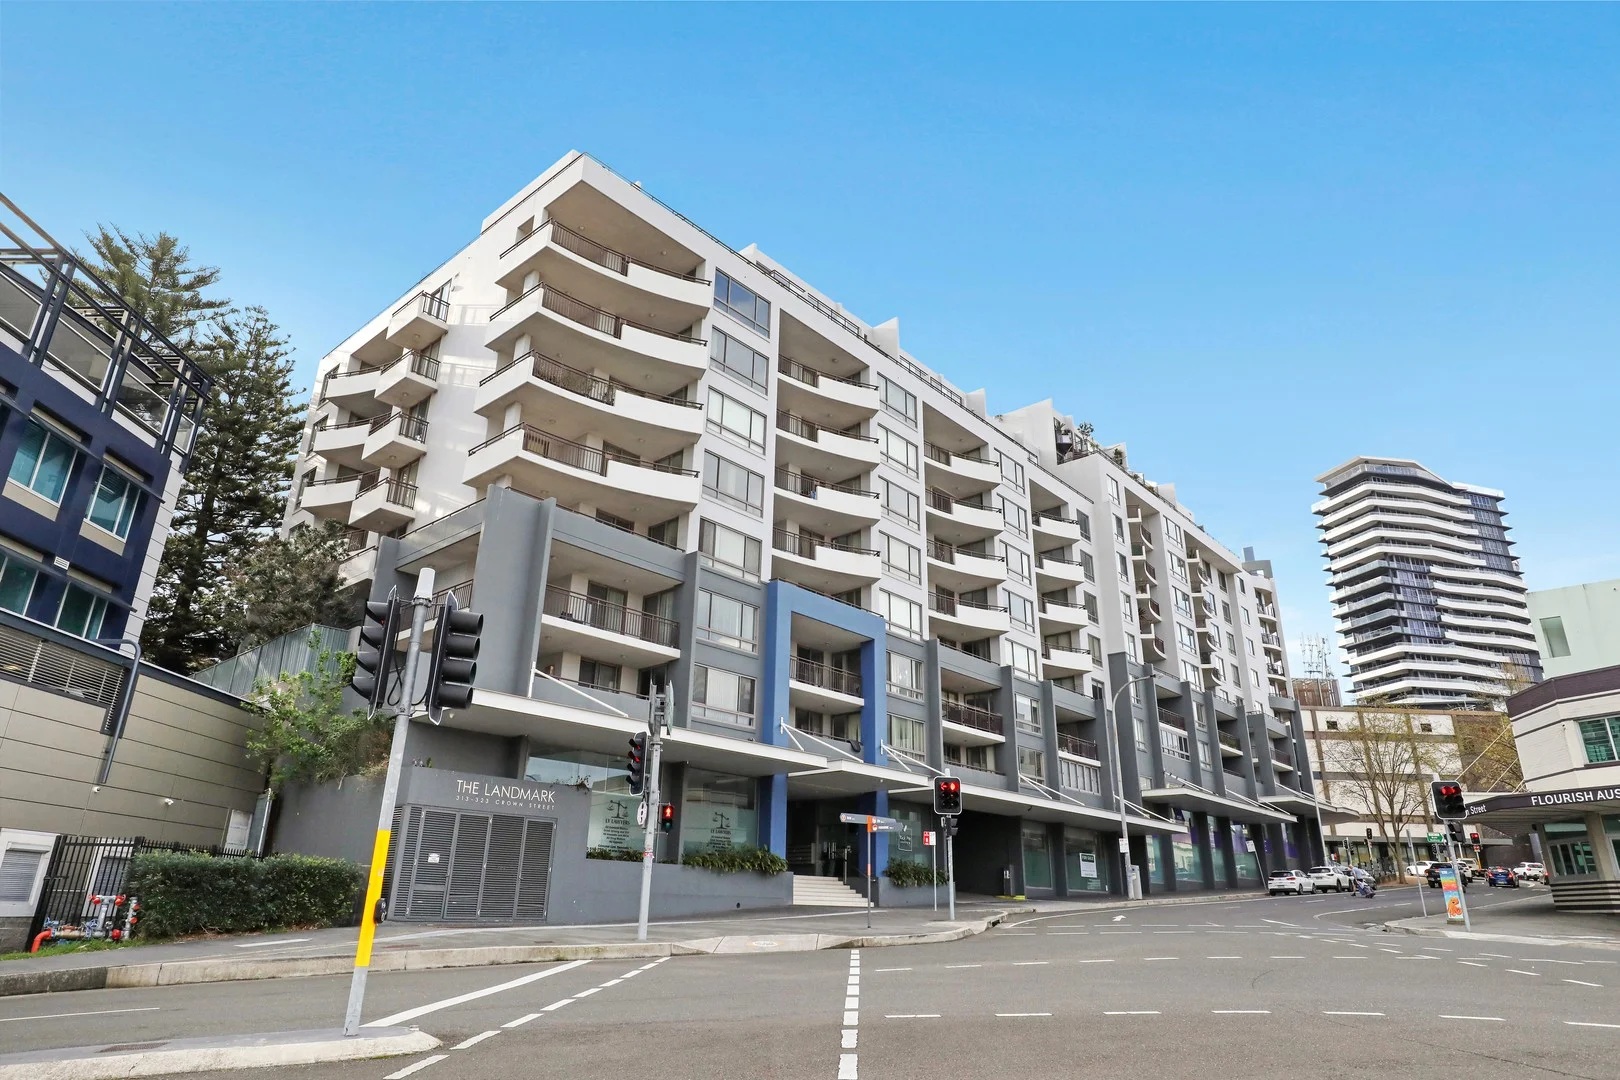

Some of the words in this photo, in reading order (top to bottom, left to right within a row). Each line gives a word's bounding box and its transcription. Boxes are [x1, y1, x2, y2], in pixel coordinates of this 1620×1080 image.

[456, 780, 480, 794] THE
[484, 784, 556, 802] LANDMARK
[1531, 790, 1594, 806] FLOURISH
[1470, 804, 1487, 815] Street
